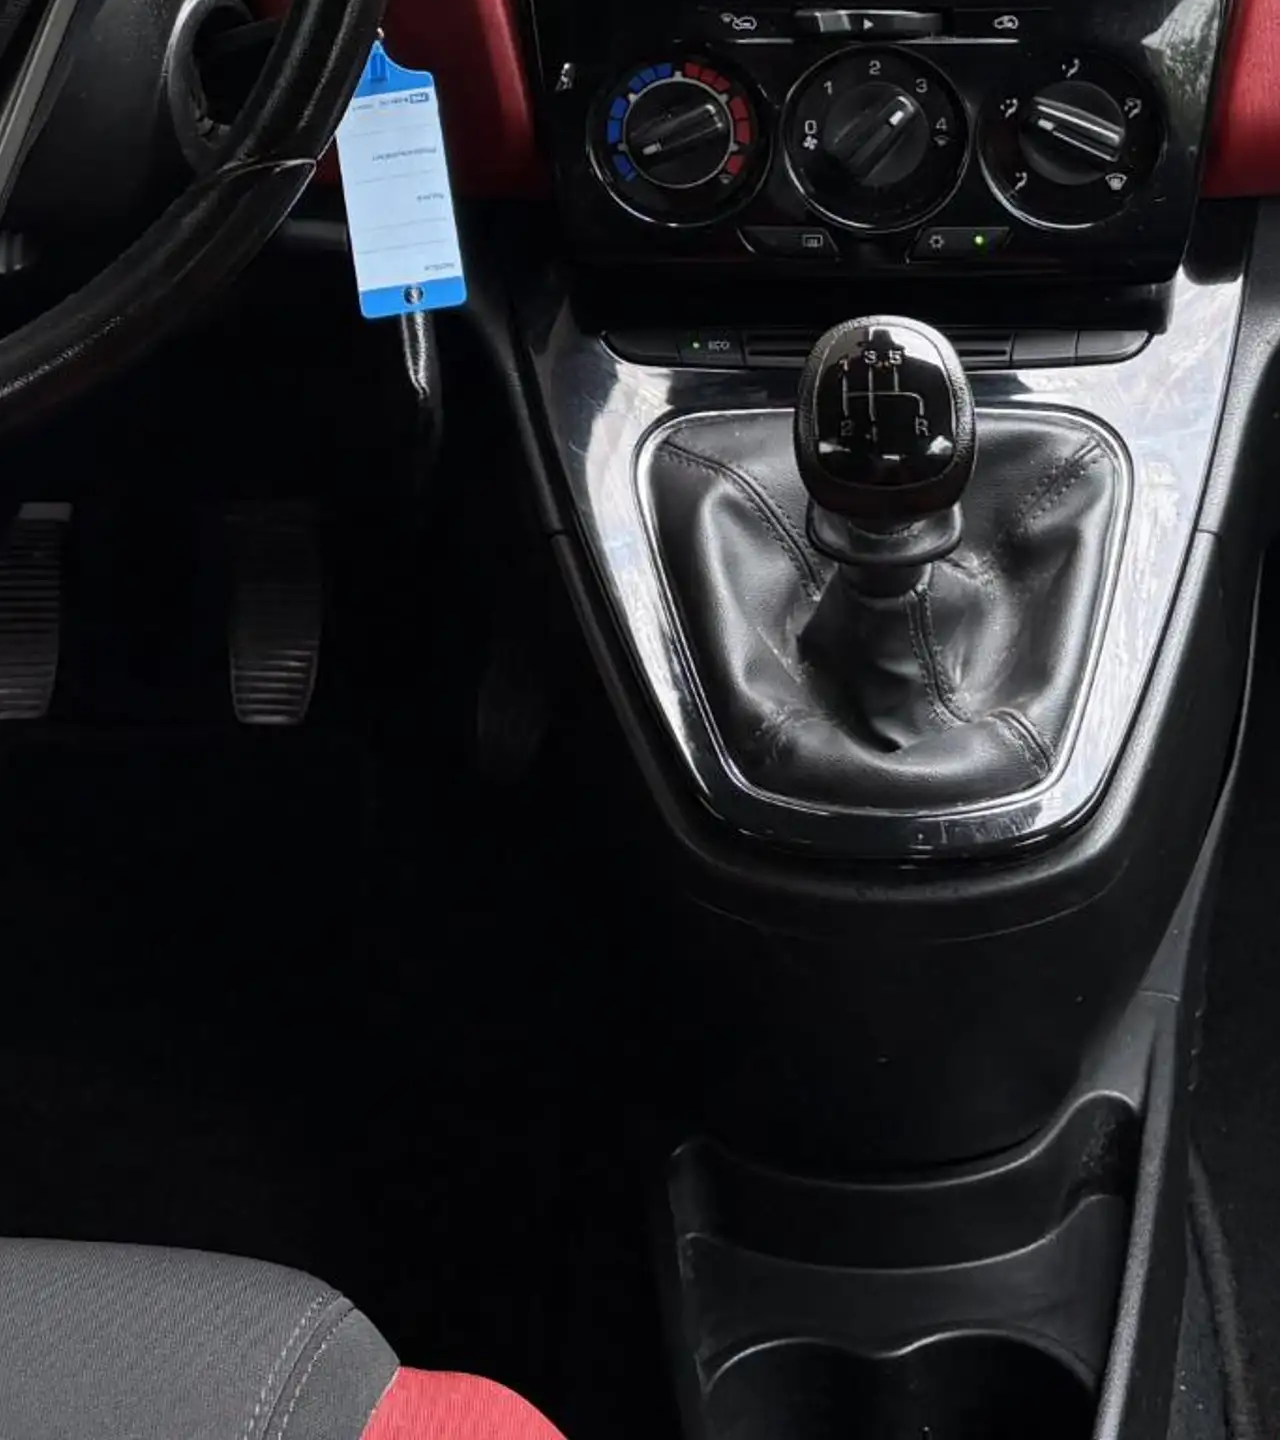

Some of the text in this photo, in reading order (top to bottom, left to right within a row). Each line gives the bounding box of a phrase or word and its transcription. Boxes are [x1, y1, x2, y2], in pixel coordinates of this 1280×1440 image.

[869, 60, 881, 75] 2
[824, 80, 833, 95] 1
[915, 78, 928, 93] 3
[804, 120, 817, 134] 0
[935, 117, 947, 130] 4
[708, 340, 730, 350] ECO
[864, 350, 902, 364] 3 5
[839, 358, 849, 371] 1
[841, 421, 853, 436] 2
[916, 417, 929, 436] R
